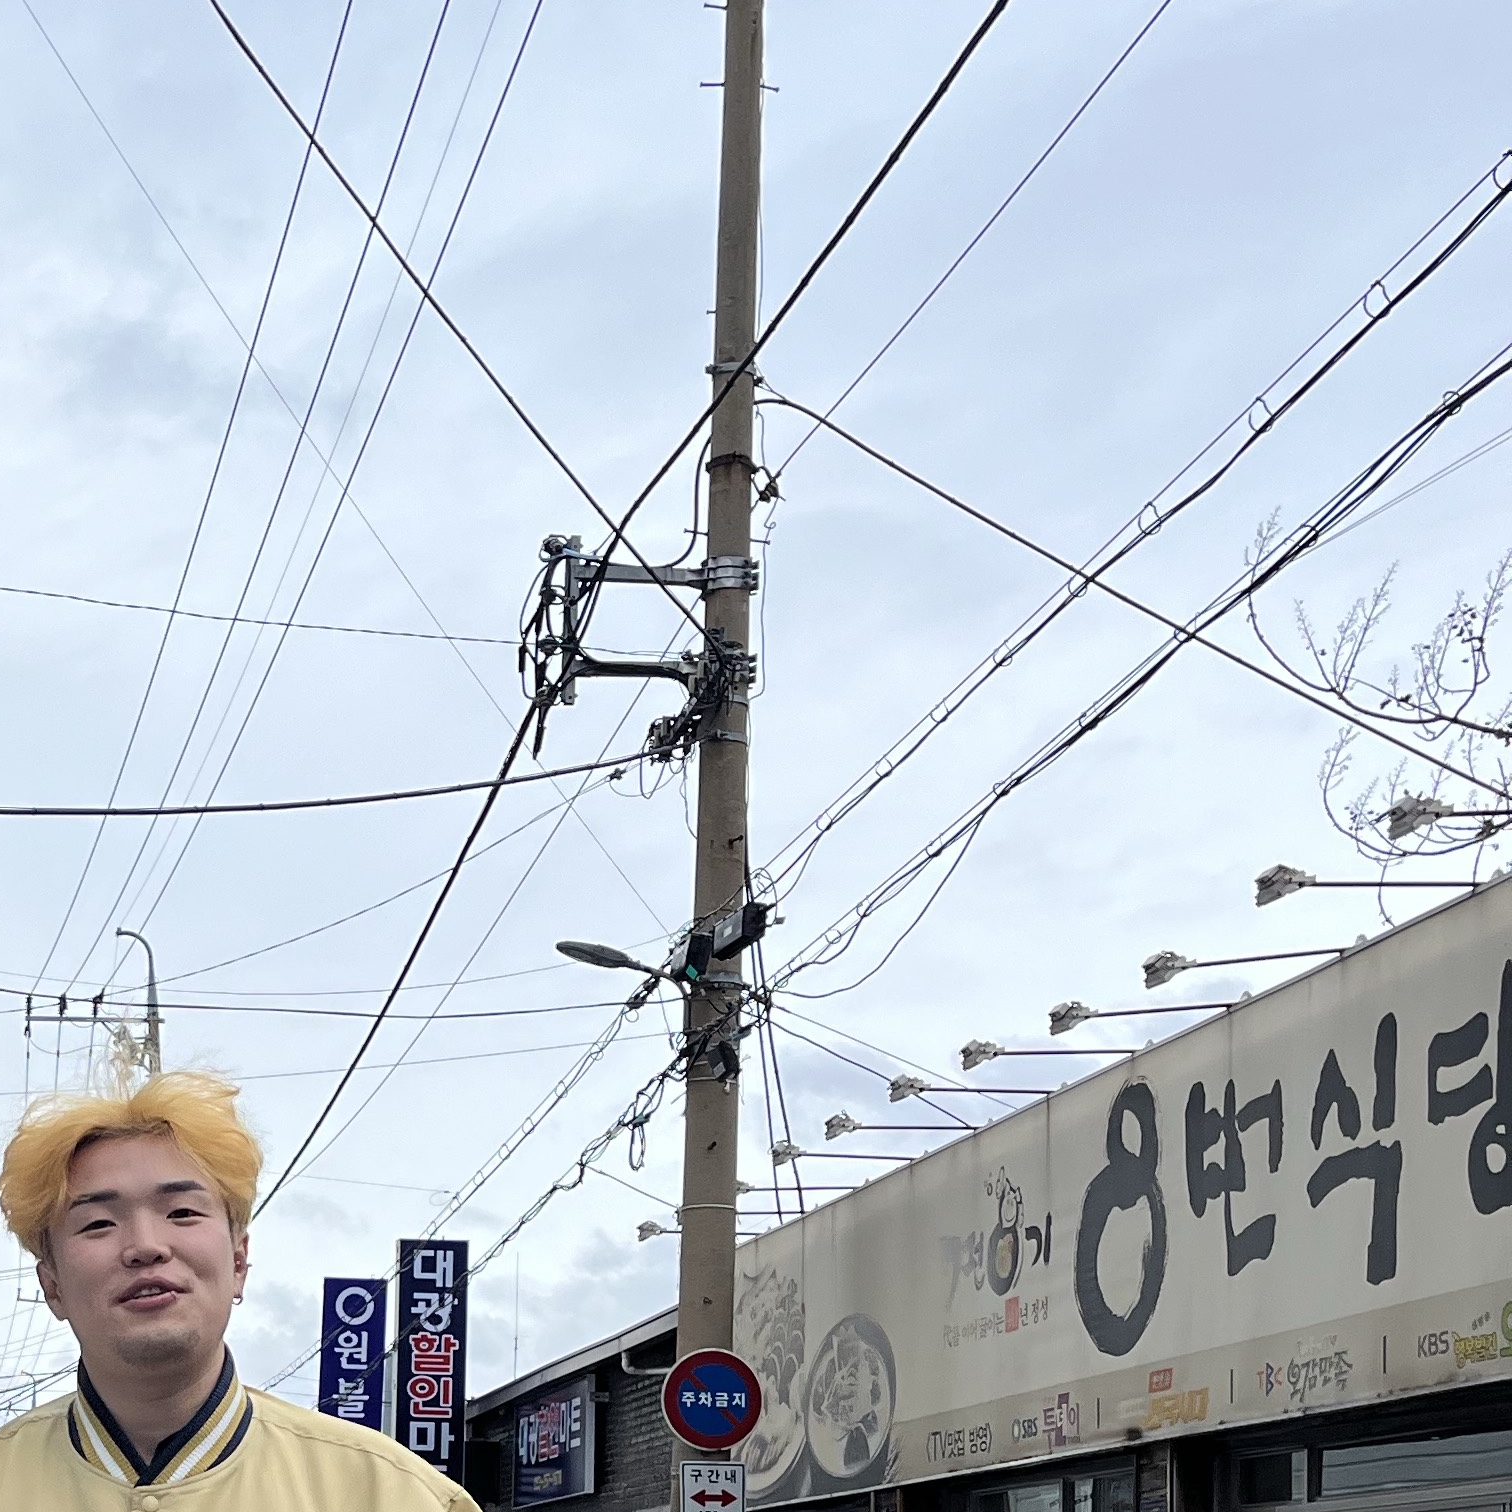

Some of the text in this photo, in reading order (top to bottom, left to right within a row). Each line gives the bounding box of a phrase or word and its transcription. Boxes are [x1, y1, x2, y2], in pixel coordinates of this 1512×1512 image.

[1031, 1295, 1049, 1325] 정성
[1417, 1330, 1450, 1359] KBS
[1256, 1362, 1283, 1398] TBC
[680, 1389, 747, 1410] 주차금지
[1021, 1417, 1038, 1439] SBS
